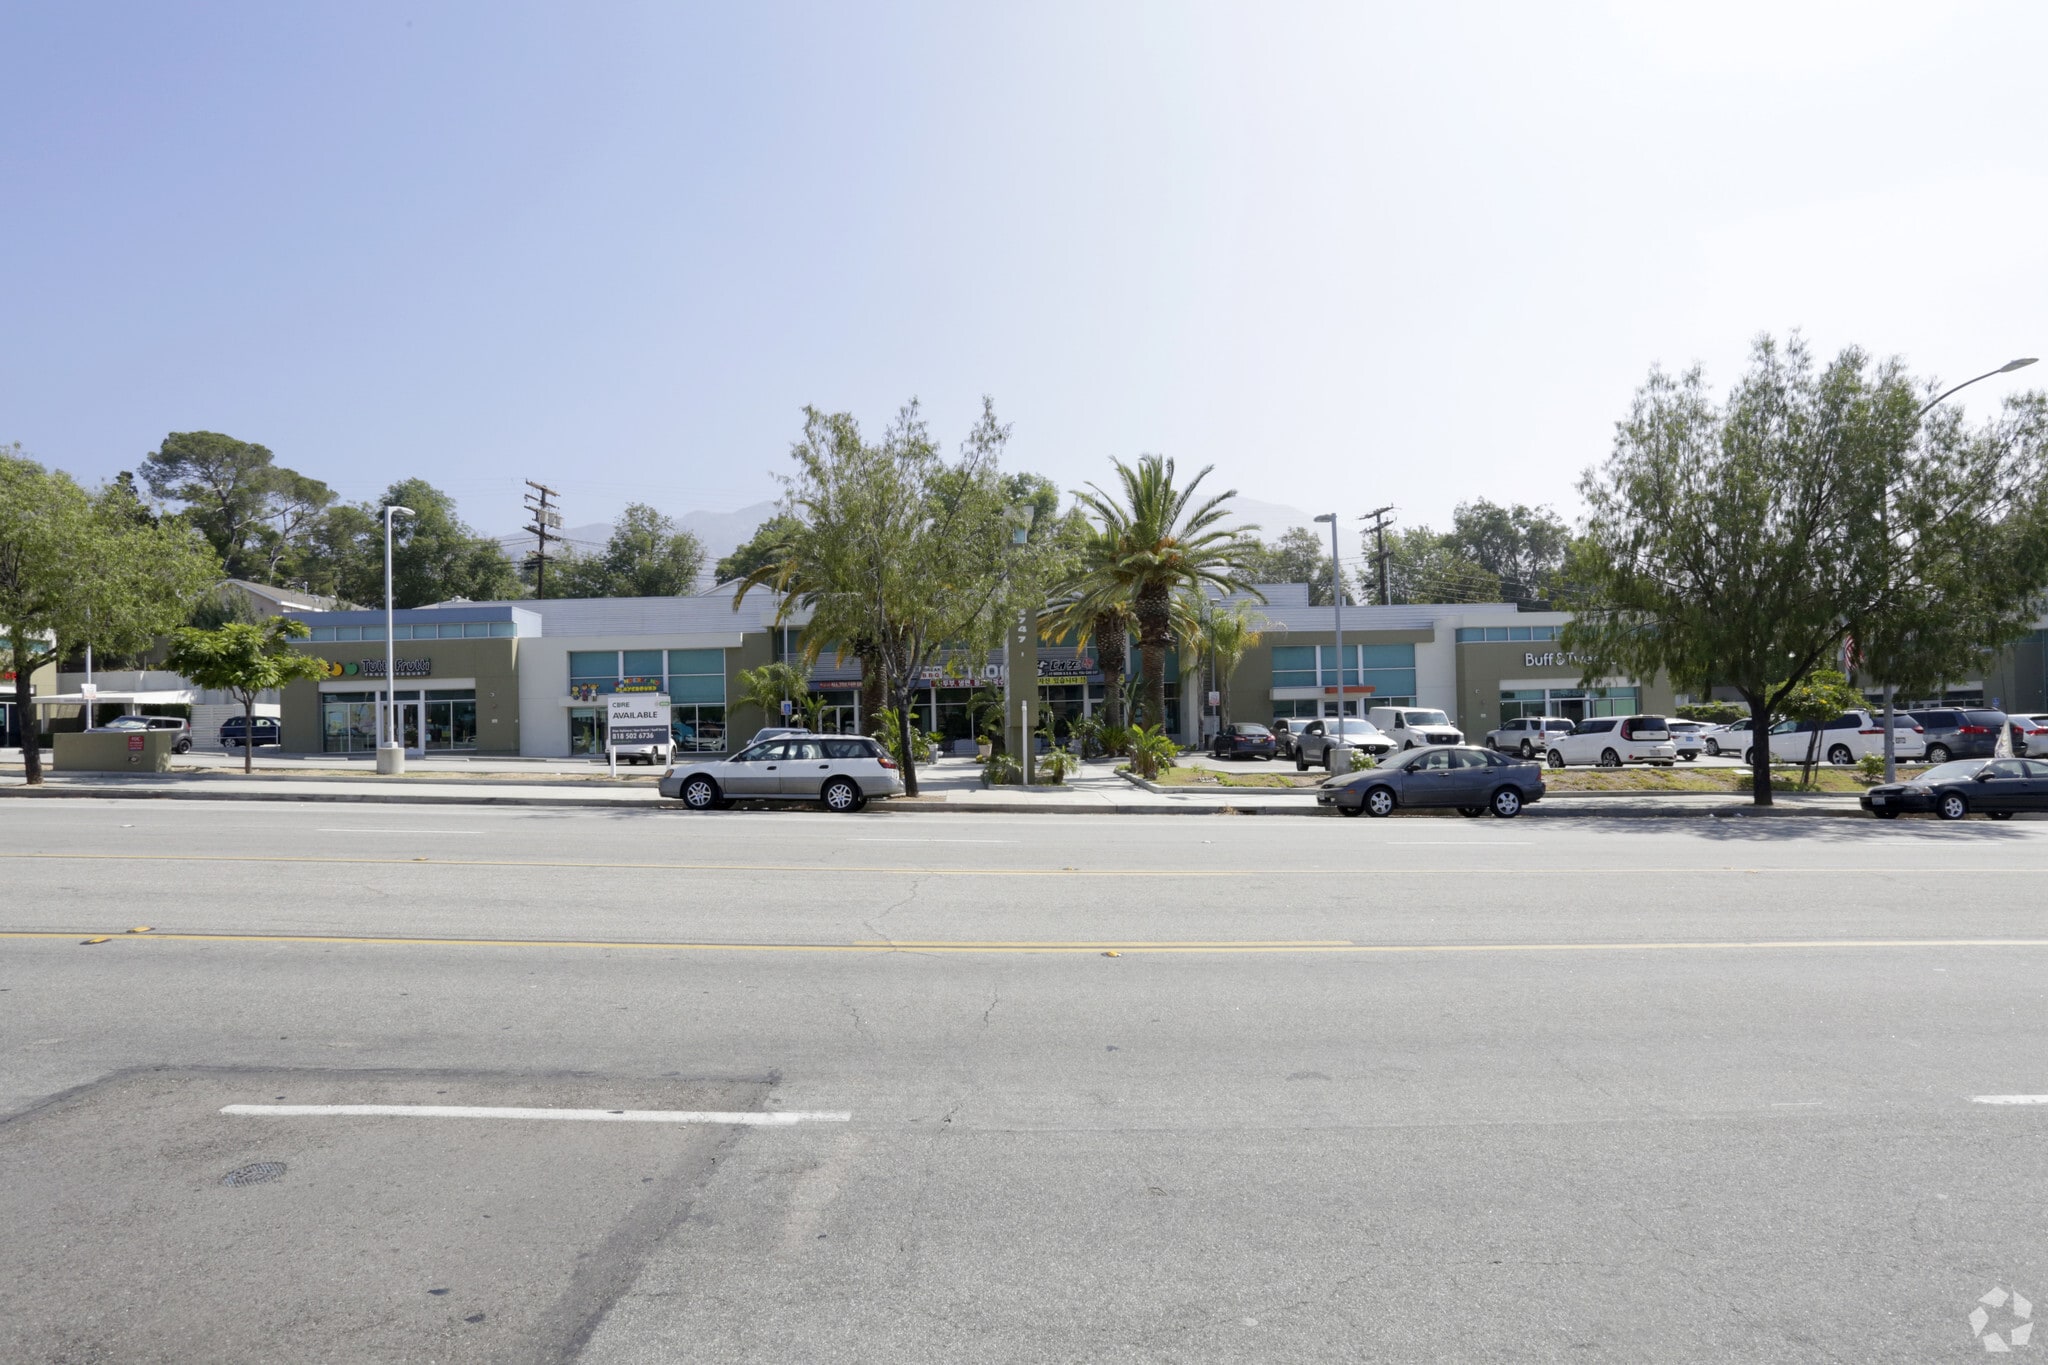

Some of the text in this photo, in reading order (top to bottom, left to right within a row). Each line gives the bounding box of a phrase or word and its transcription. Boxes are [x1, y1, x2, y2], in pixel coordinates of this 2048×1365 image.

[362, 658, 431, 672] Tutt Frutti
[1525, 652, 1554, 666] Buff
[1556, 652, 1566, 666] &
[612, 711, 659, 719] AVAILABLE
